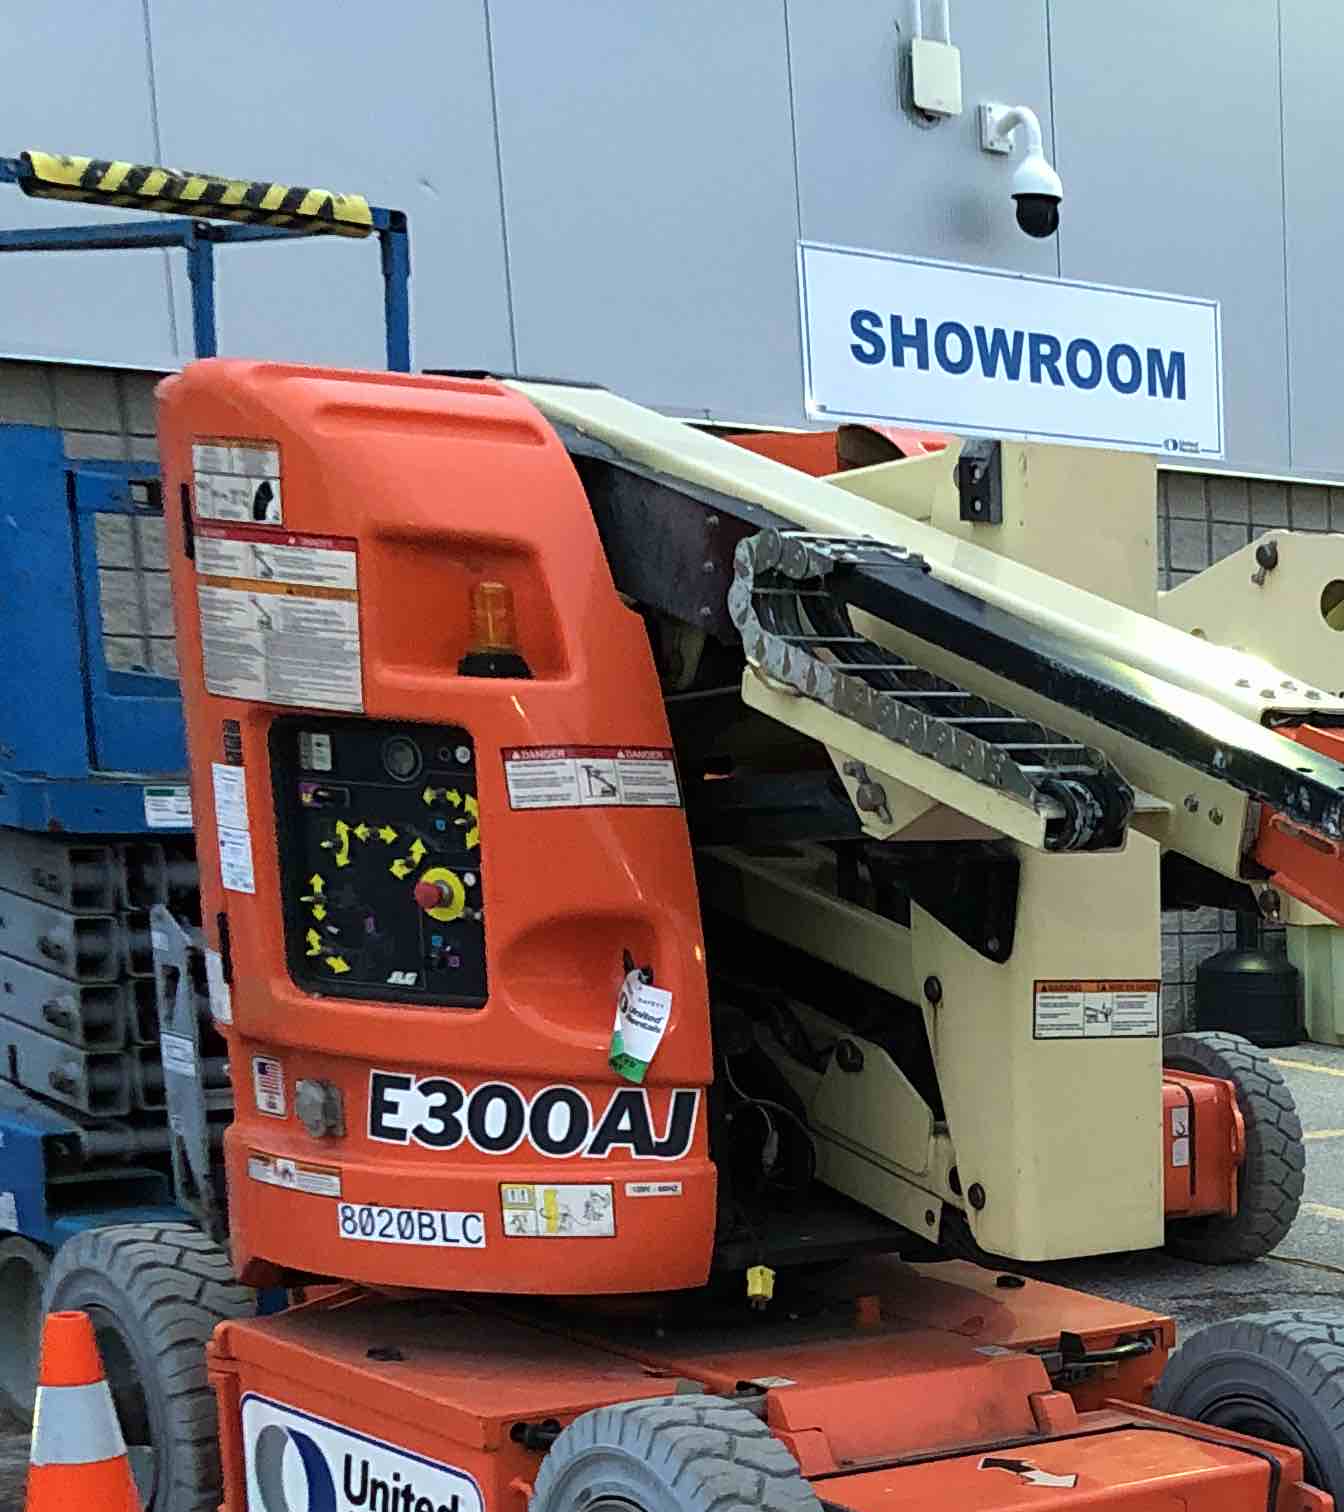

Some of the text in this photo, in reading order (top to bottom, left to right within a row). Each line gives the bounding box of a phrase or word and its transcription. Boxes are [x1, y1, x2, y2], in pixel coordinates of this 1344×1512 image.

[849, 308, 1187, 401] SHOWROOM
[369, 1070, 700, 1159] E300AJ
[340, 1205, 483, 1244] 8020BLC
